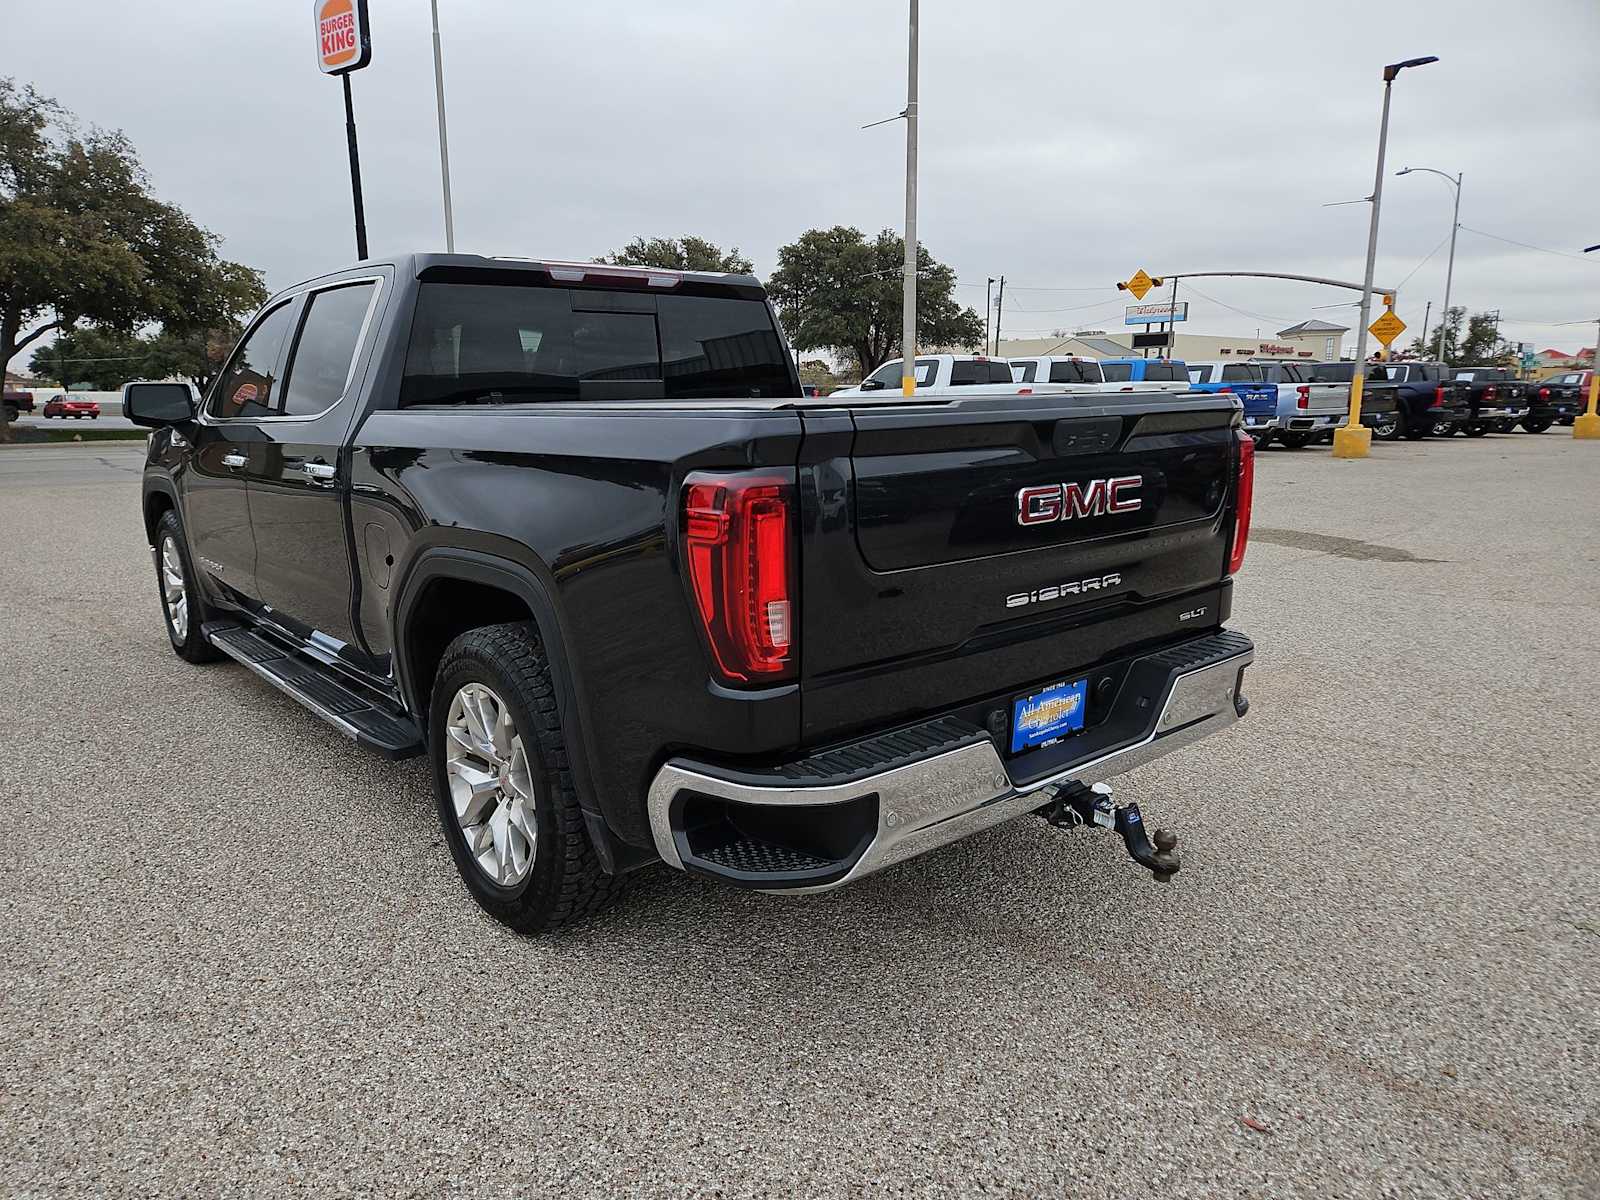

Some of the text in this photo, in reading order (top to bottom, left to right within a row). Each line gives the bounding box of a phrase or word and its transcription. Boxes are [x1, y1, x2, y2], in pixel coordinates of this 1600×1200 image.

[320, 13, 354, 36] BURGER
[321, 28, 356, 56] KING
[1017, 474, 1143, 527] GMC
[1005, 573, 1122, 608] SIERRA
[1178, 606, 1208, 622] SLT
[1019, 702, 1034, 719] All
